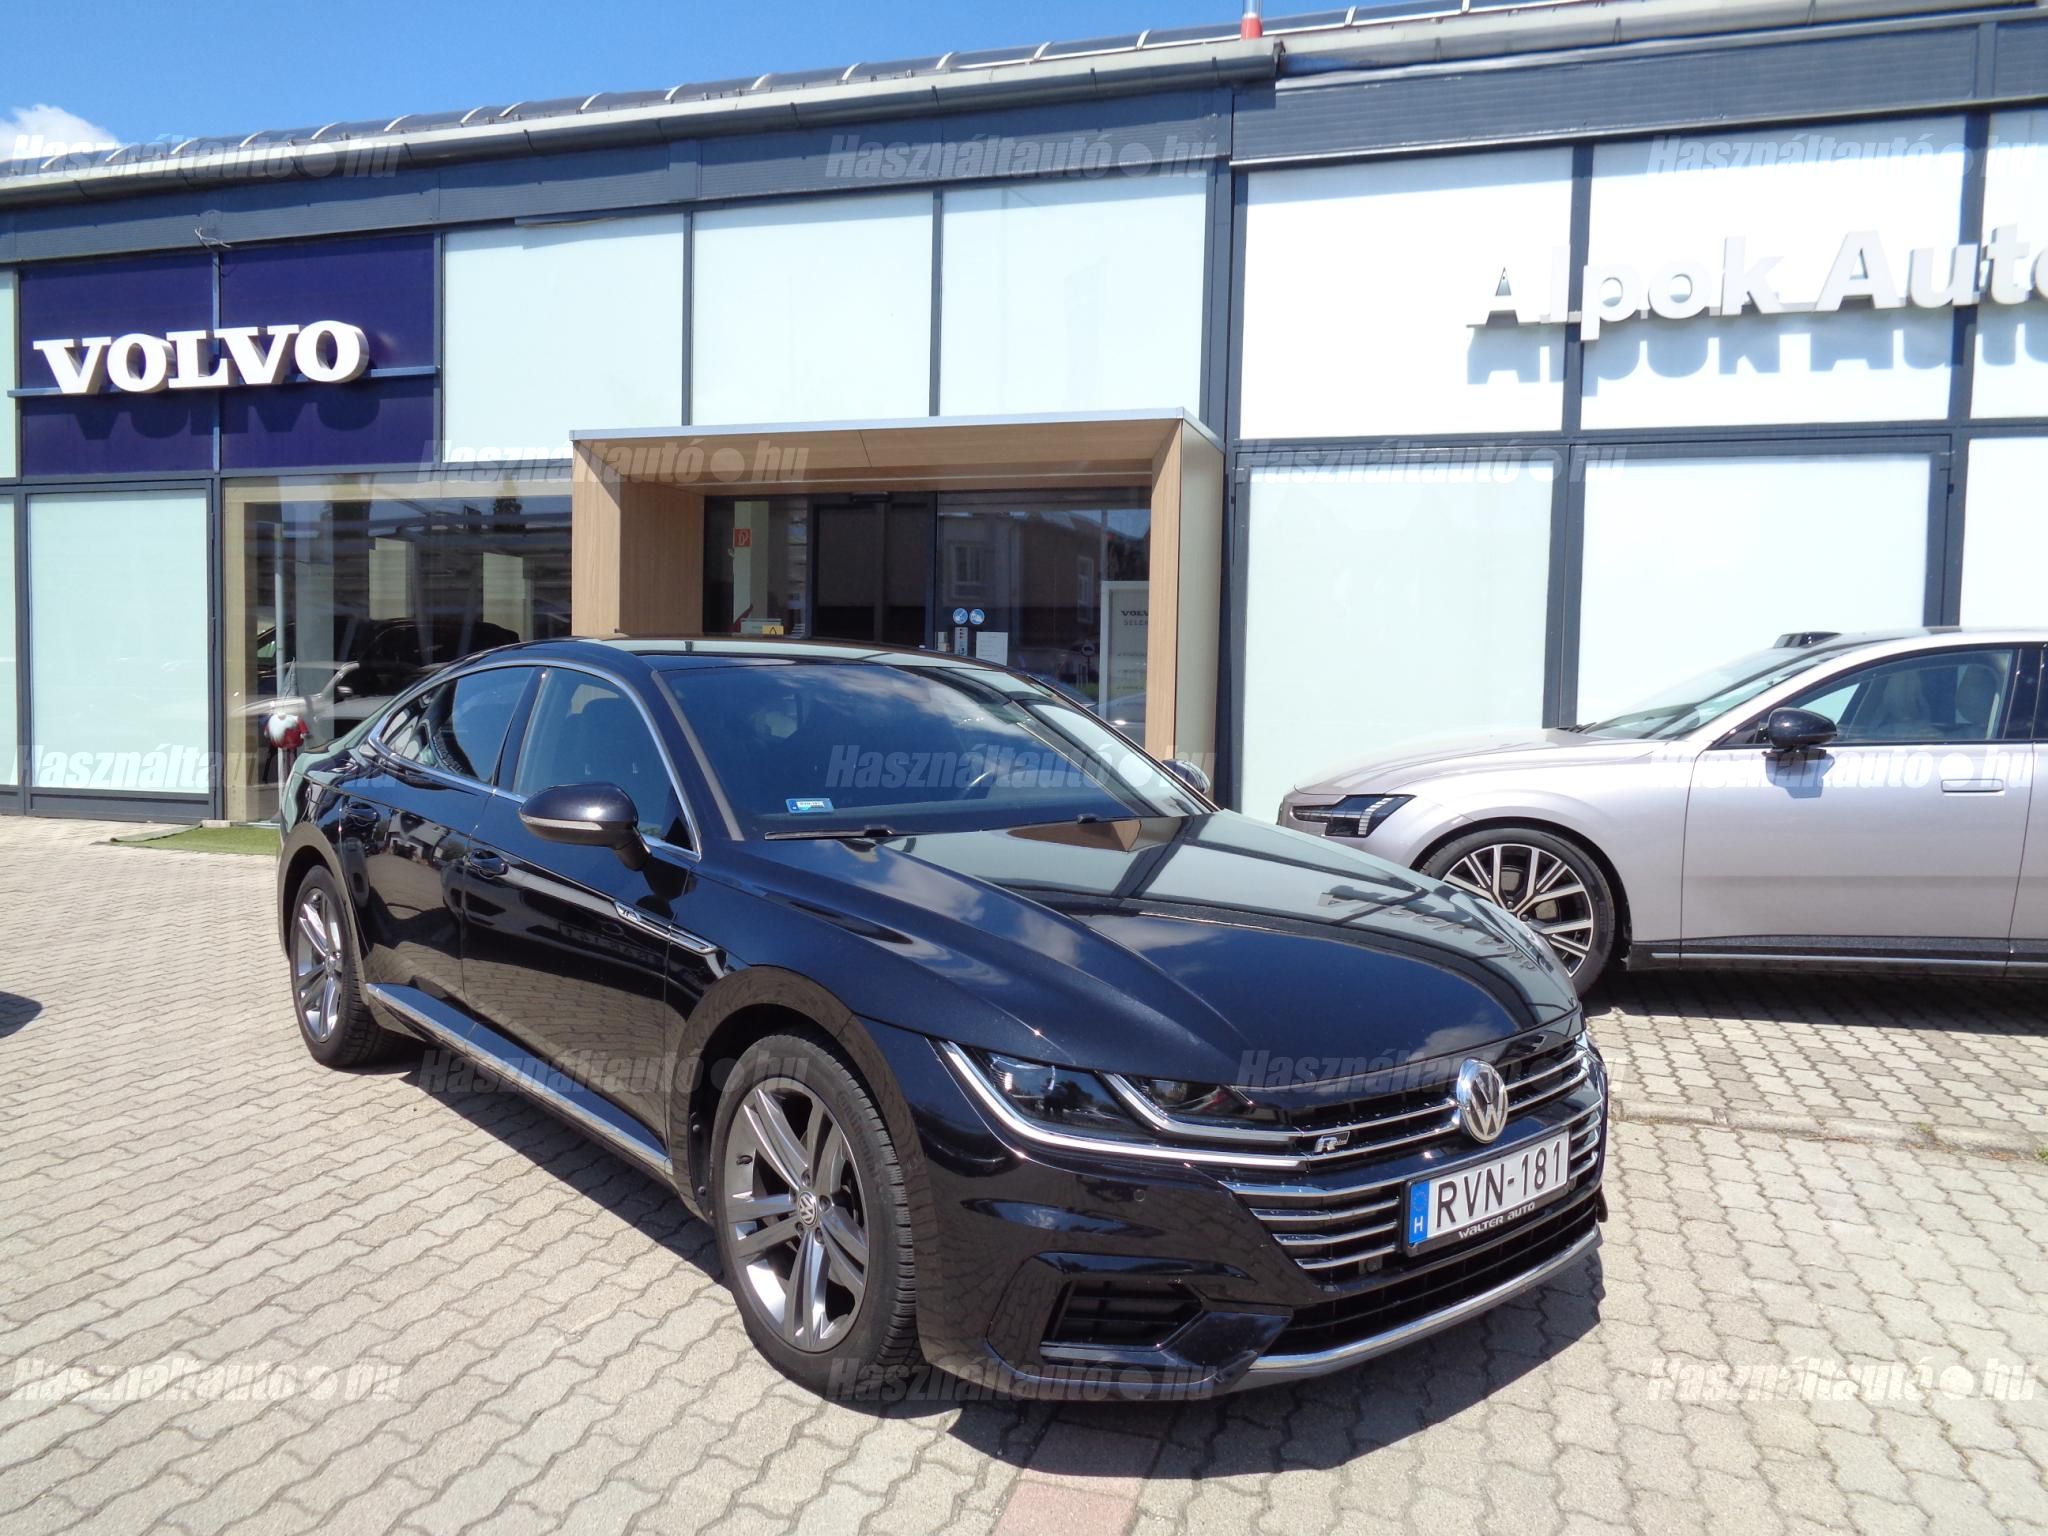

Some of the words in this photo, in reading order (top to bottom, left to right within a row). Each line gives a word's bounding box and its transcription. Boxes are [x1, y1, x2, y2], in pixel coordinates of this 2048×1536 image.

[1466, 237, 1788, 342] Alpok
[1814, 223, 2048, 310] Aut
[33, 319, 369, 394] VOLVO
[1413, 1215, 1424, 1234] H
[1436, 1140, 1561, 1228] RVN-181
